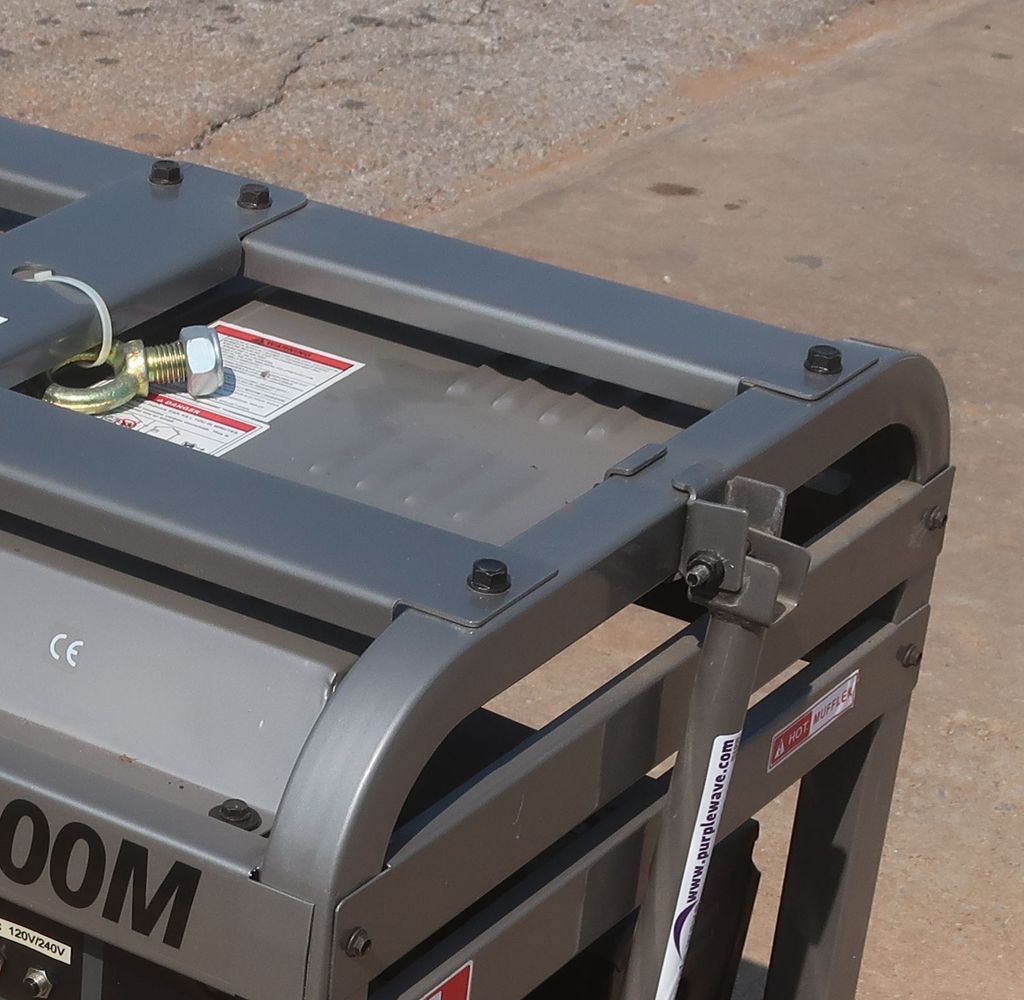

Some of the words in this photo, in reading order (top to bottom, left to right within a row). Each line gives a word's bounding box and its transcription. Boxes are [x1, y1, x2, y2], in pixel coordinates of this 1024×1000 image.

[814, 687, 854, 721] MUFFLER
[788, 720, 809, 745] HOT
[687, 739, 735, 904] www.purplewave.com
[8, 926, 66, 957] 120V/240V
